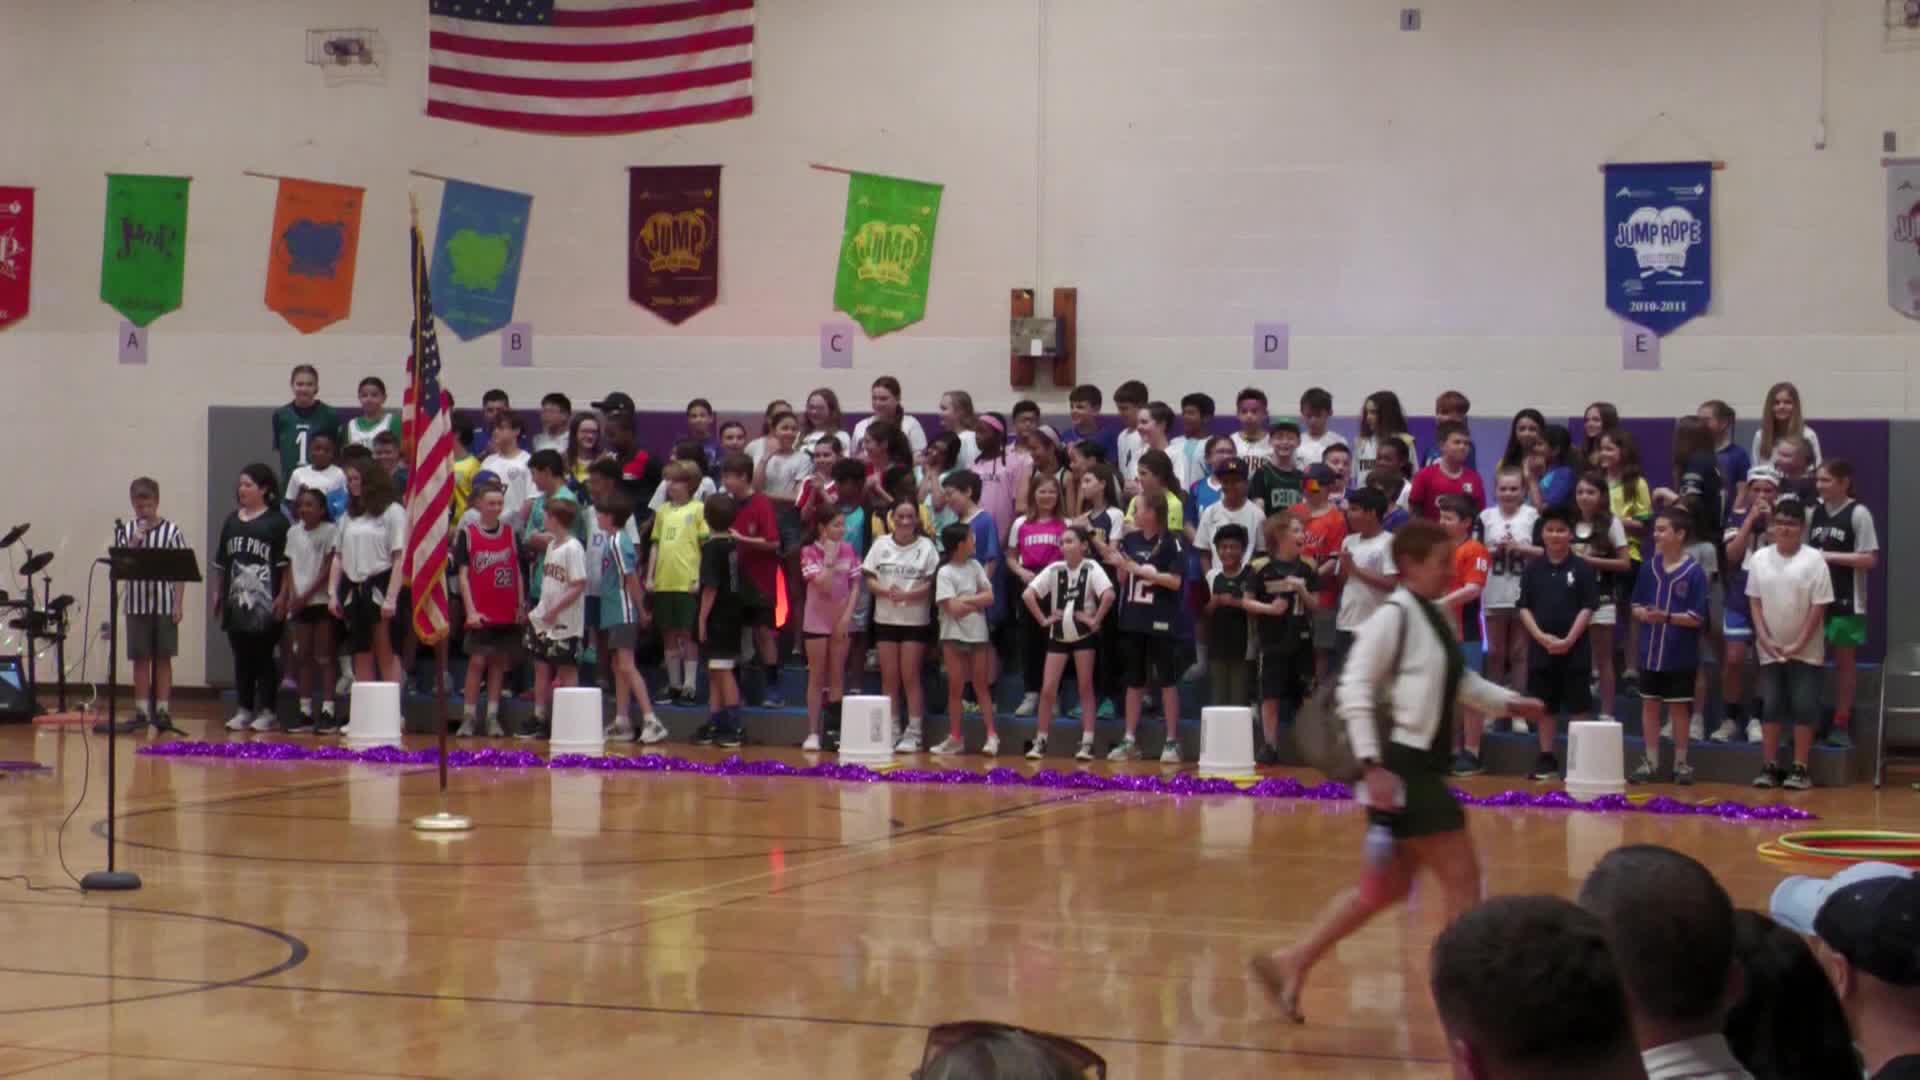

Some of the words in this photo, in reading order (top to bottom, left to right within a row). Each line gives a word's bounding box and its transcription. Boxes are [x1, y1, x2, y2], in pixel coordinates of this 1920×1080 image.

[647, 218, 704, 257] JUMP
[1615, 223, 1659, 247] JUMP
[1660, 219, 1702, 247] ROPE
[1628, 301, 1687, 313] 2010-2011
[127, 332, 139, 349] A
[511, 333, 522, 350] B
[830, 334, 843, 352] C
[1264, 334, 1279, 352] D
[1635, 335, 1649, 353] E
[295, 430, 308, 466] 1
